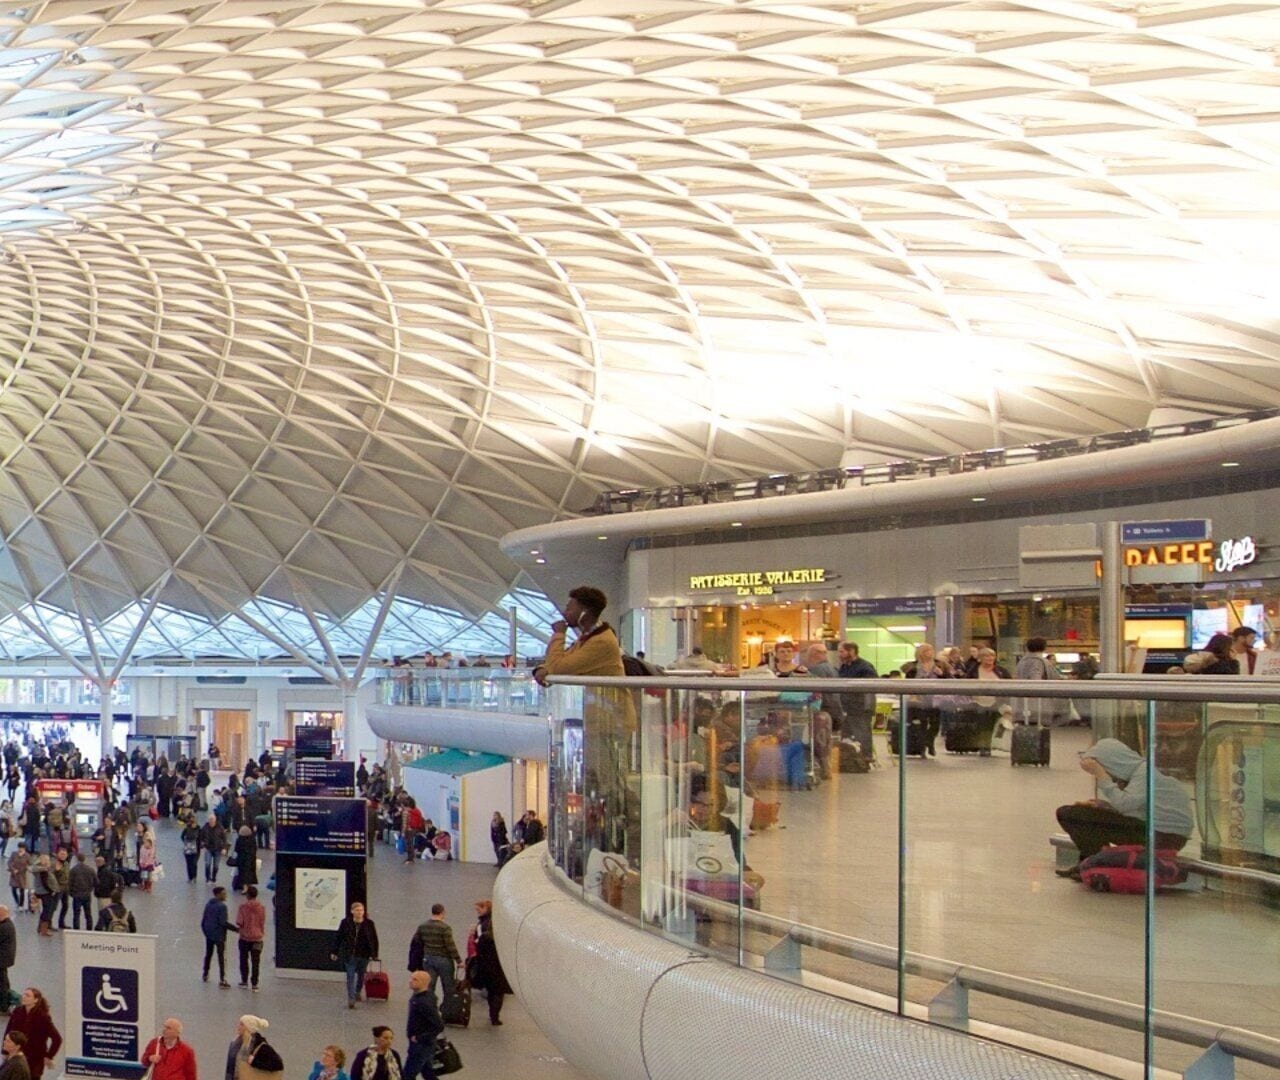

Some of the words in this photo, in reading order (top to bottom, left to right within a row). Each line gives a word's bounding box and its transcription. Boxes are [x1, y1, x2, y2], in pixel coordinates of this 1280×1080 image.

[690, 572, 762, 589] PATISSERIE
[766, 568, 825, 584] VALERIE
[82, 943, 115, 952] Meeting
[117, 945, 139, 953] Point
